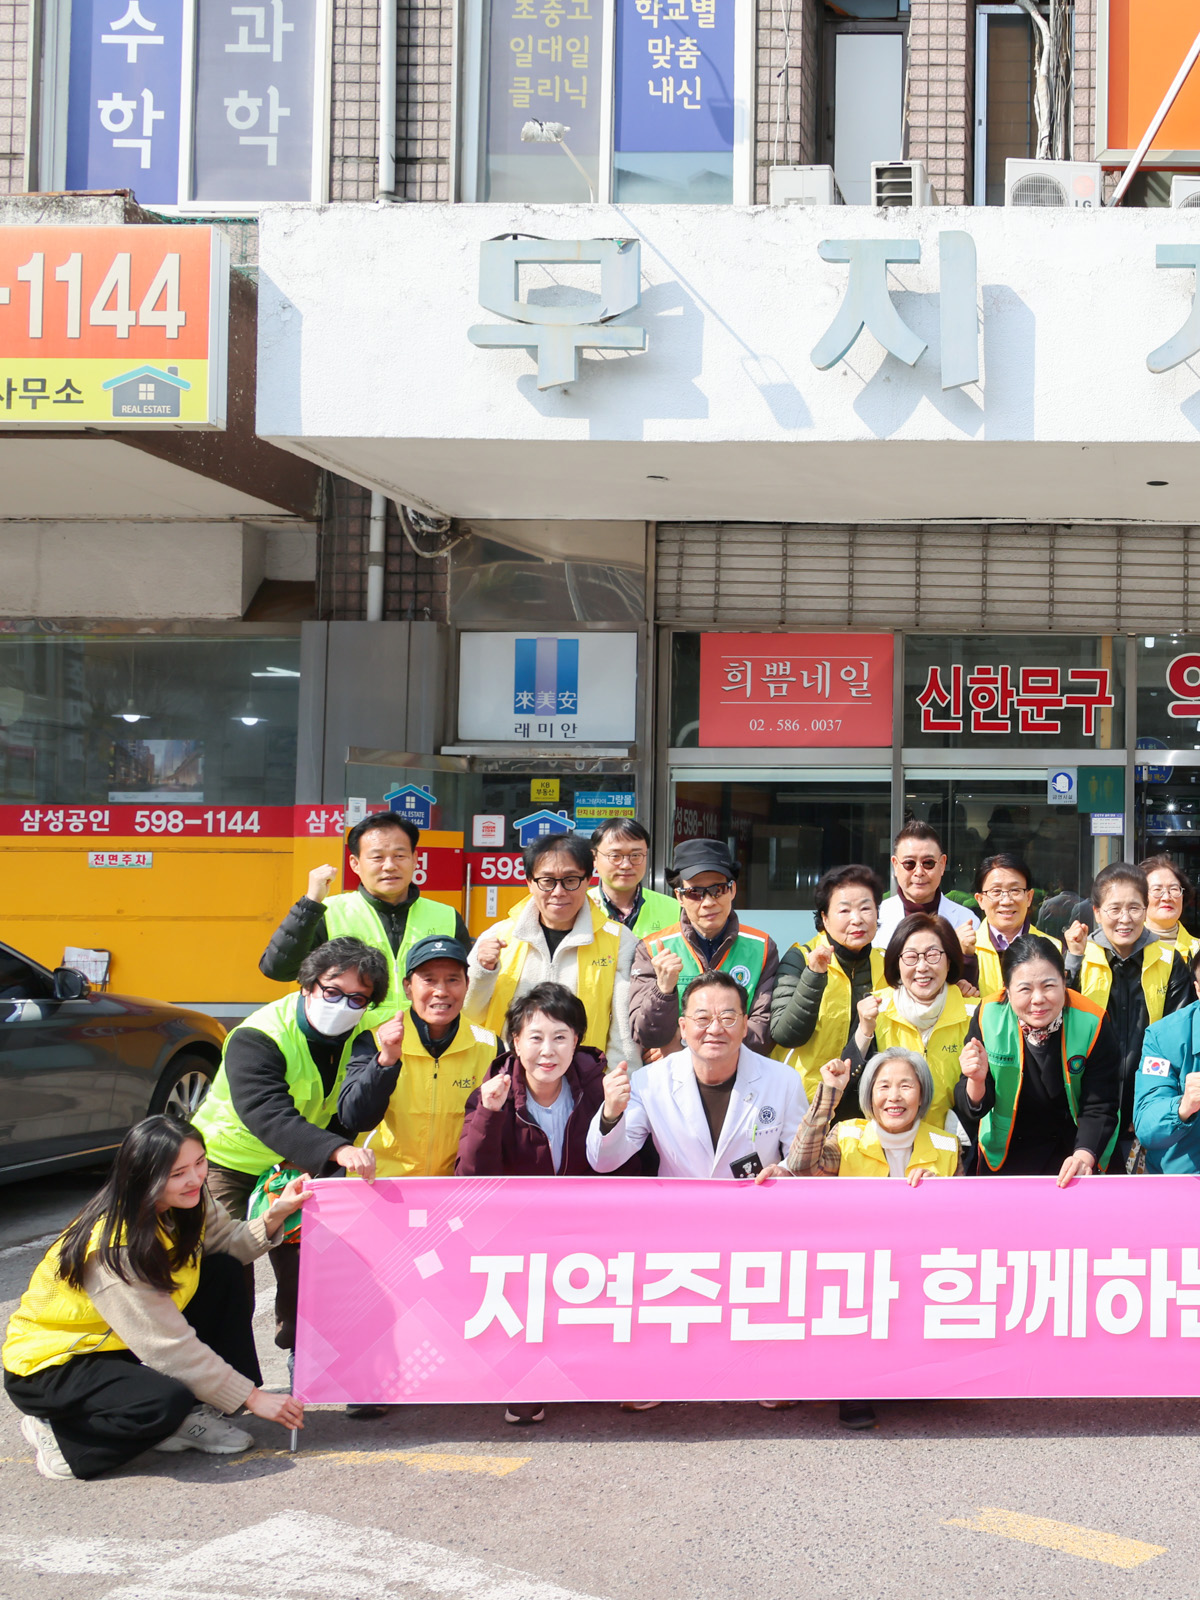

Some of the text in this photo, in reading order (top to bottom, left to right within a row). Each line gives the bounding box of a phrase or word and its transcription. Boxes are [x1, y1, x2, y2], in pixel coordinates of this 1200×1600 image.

[635, 0, 716, 29] 학교별
[510, 34, 590, 69] 일대일
[648, 35, 702, 70] 맞춤
[508, 75, 588, 109] 클리닉
[648, 75, 702, 110] 내신
[121, 404, 171, 415] REAL ESTATE
[721, 660, 873, 699] 희쁨네일
[515, 690, 578, 710] 來美安
[916, 664, 1114, 736] 신한문구
[513, 722, 578, 739] 래미안
[535, 788, 555, 797] 부동산
[19, 809, 261, 834] 삼성공인 598-1144
[408, 811, 424, 819] ESTATE
[93, 853, 147, 867] 전면주차
[452, 1078, 471, 1089] 서초
[463, 1249, 900, 1344] 지역주민과
